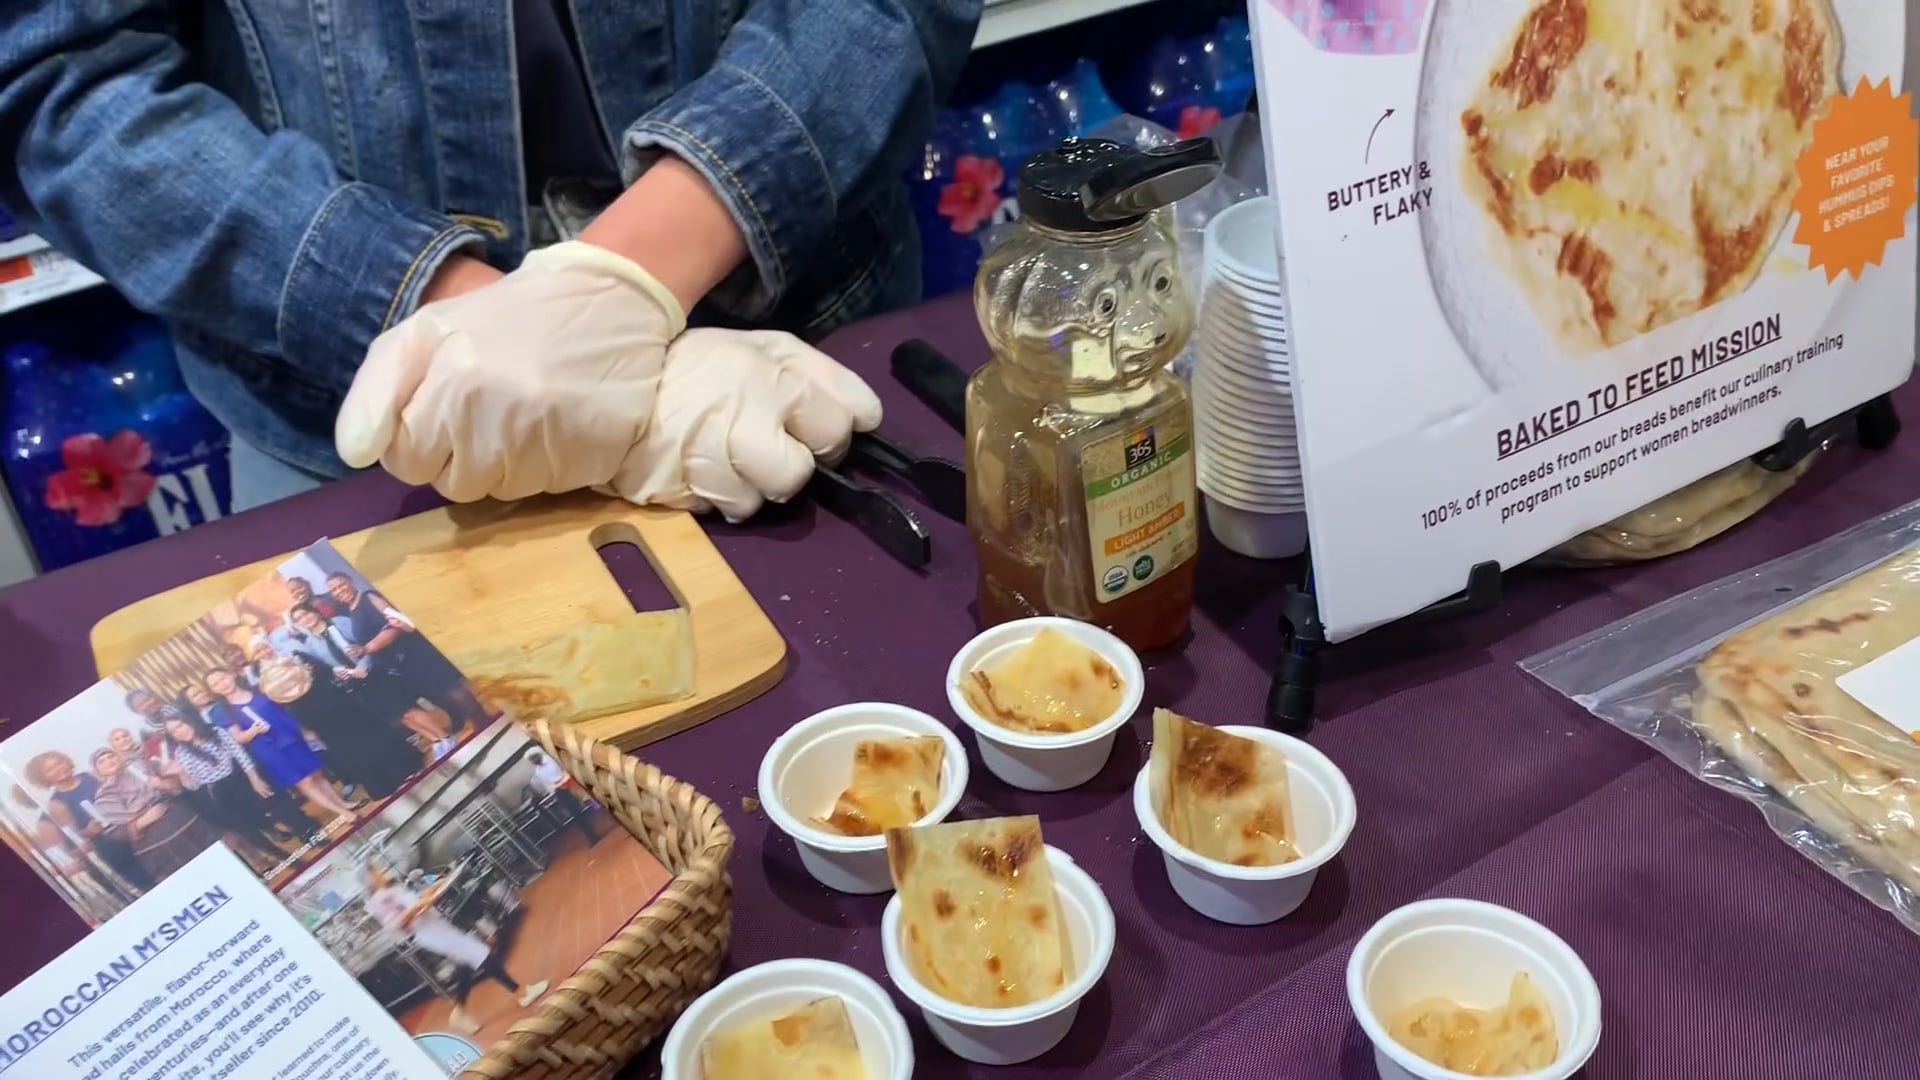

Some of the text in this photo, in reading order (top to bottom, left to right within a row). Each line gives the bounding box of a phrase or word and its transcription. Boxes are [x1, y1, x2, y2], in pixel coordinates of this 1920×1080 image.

[1825, 135, 1889, 170] NEAR YOUR
[1831, 158, 1884, 189] FAVORITE
[1327, 161, 1431, 212] BUTTERY &
[1373, 187, 1432, 225] FLAKY
[1819, 174, 1895, 214] HUMMUS DIPS
[1823, 195, 1890, 232] & SPREADS!
[1496, 313, 1781, 457] BAKED TO FEED MISSION
[1128, 440, 1152, 463] 365
[1421, 333, 1844, 529] 100% of proceeds from our breads benefit our culinary training
[1501, 385, 1782, 524] program to support women breadwinners.
[1111, 451, 1172, 488] ORGANIC
[1113, 529, 1146, 550] LIGHT
[1148, 508, 1181, 534] AMBER
[1118, 492, 1173, 527] Honey
[263, 843, 313, 881] Graduation
[310, 830, 328, 846] Fall
[132, 885, 229, 960] M'SMEN
[67, 919, 260, 1068] This versatile, flavor-forward
[99, 1040, 137, 1071] hails
[135, 1014, 171, 1043] from
[168, 969, 232, 1016] Morocco,
[232, 933, 273, 968] where
[118, 946, 287, 1080] celebrated as an everyday
[255, 1015, 292, 1048] since
[288, 988, 326, 1019] 2010.
[146, 960, 298, 1080] enturies—and after one
[203, 1030, 241, 1067] you'll
[240, 1014, 265, 1036] see
[264, 989, 292, 1016] why
[292, 972, 312, 993] it's
[331, 1035, 350, 1053] one
[349, 1024, 360, 1038] of
[277, 1045, 315, 1080] learned
[313, 1036, 326, 1049] to
[324, 1015, 351, 1040] make
[333, 1035, 371, 1070] culinary
[352, 1060, 365, 1075] us
[363, 1046, 381, 1064] the
